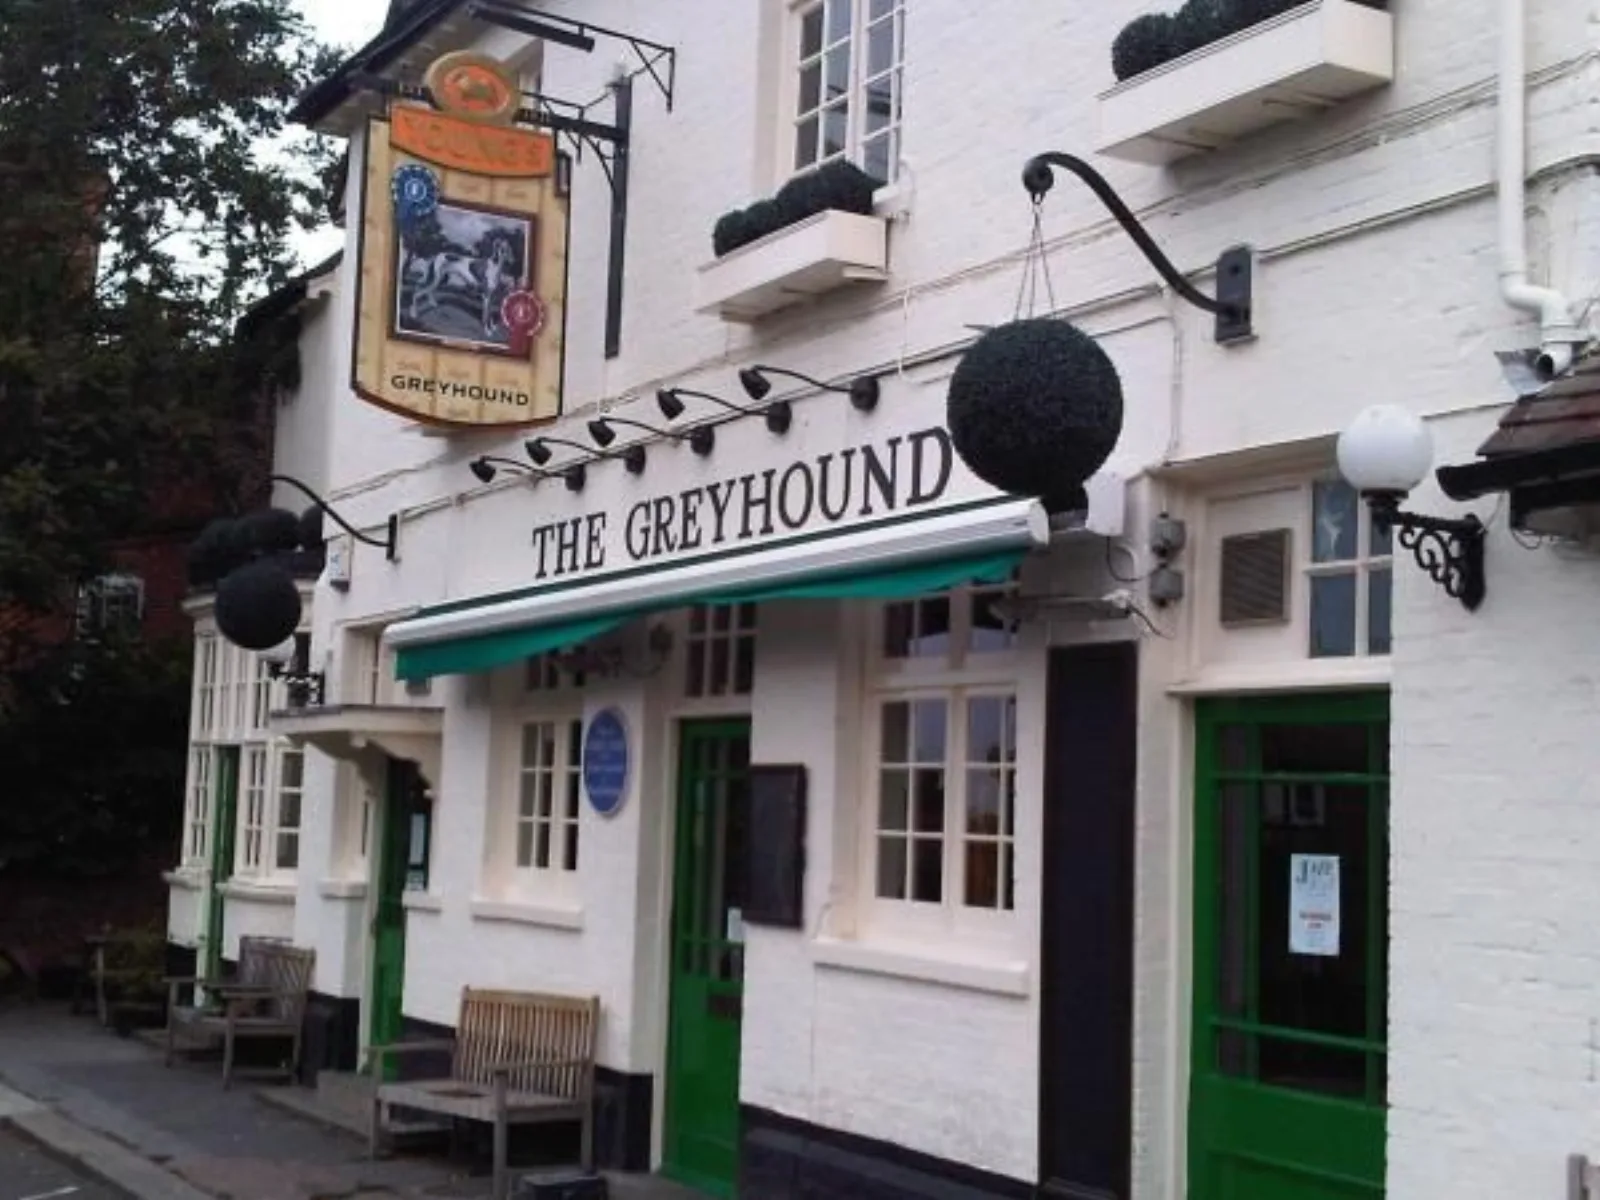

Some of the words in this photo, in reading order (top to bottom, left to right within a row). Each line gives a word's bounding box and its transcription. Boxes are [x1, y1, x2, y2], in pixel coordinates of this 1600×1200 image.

[390, 374, 530, 406] GREYHOUND
[532, 510, 607, 580] THE
[625, 425, 953, 561] GREYHOUND
